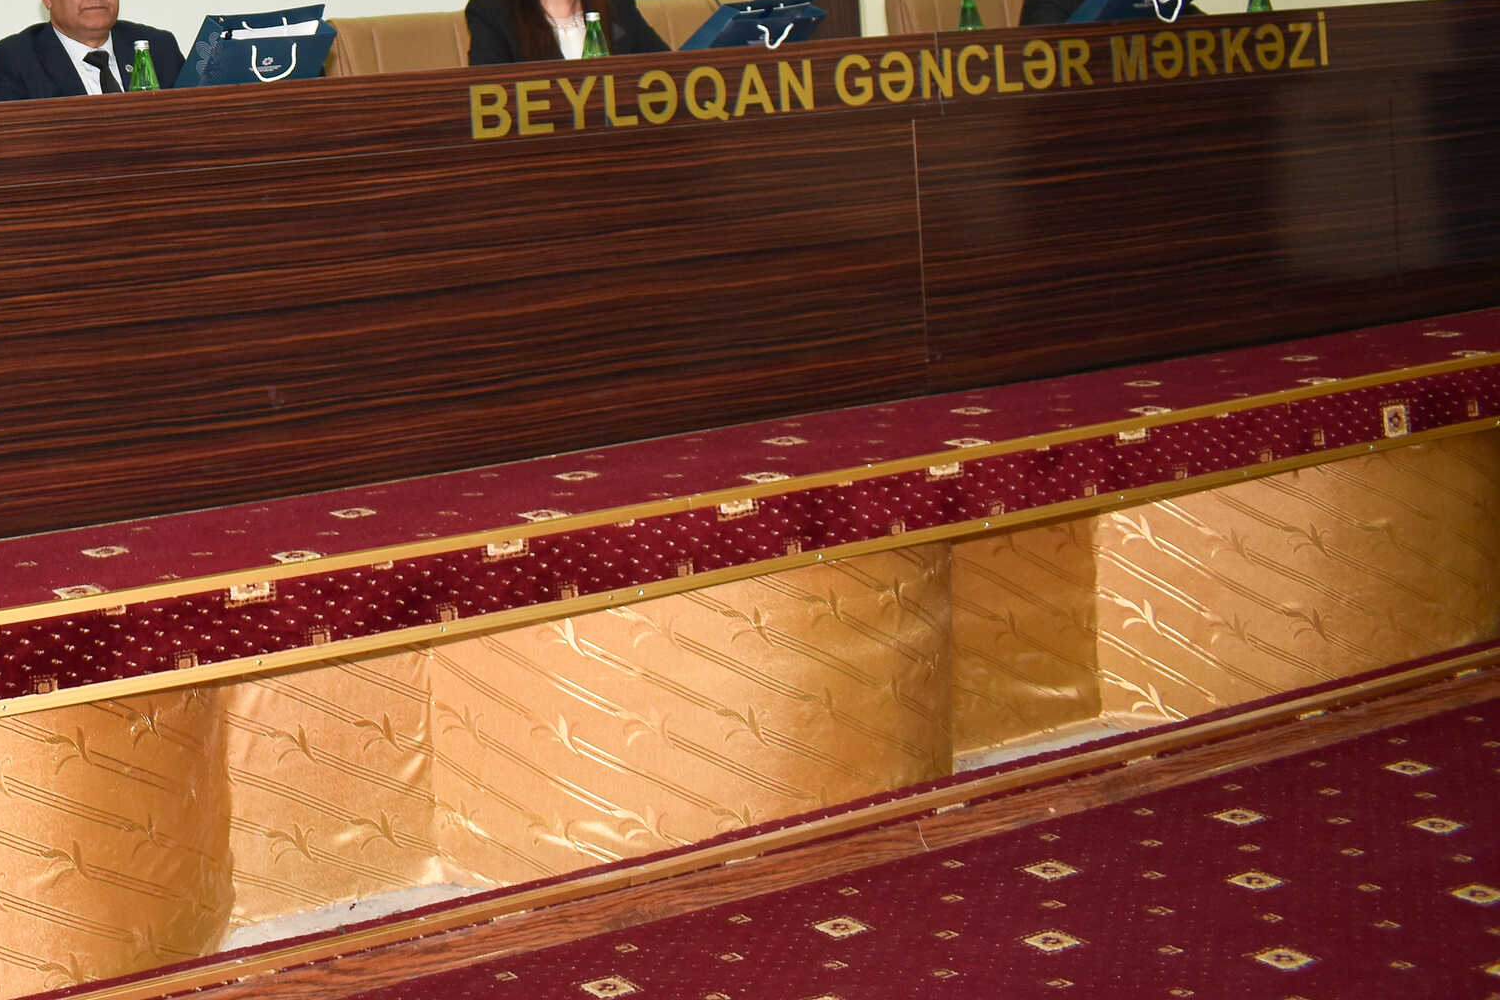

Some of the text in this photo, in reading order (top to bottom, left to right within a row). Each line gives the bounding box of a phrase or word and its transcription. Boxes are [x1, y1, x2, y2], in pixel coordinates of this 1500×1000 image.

[469, 11, 1329, 140] BEYLƏQAN GƏNCLƏR MƏRKƏZİ
